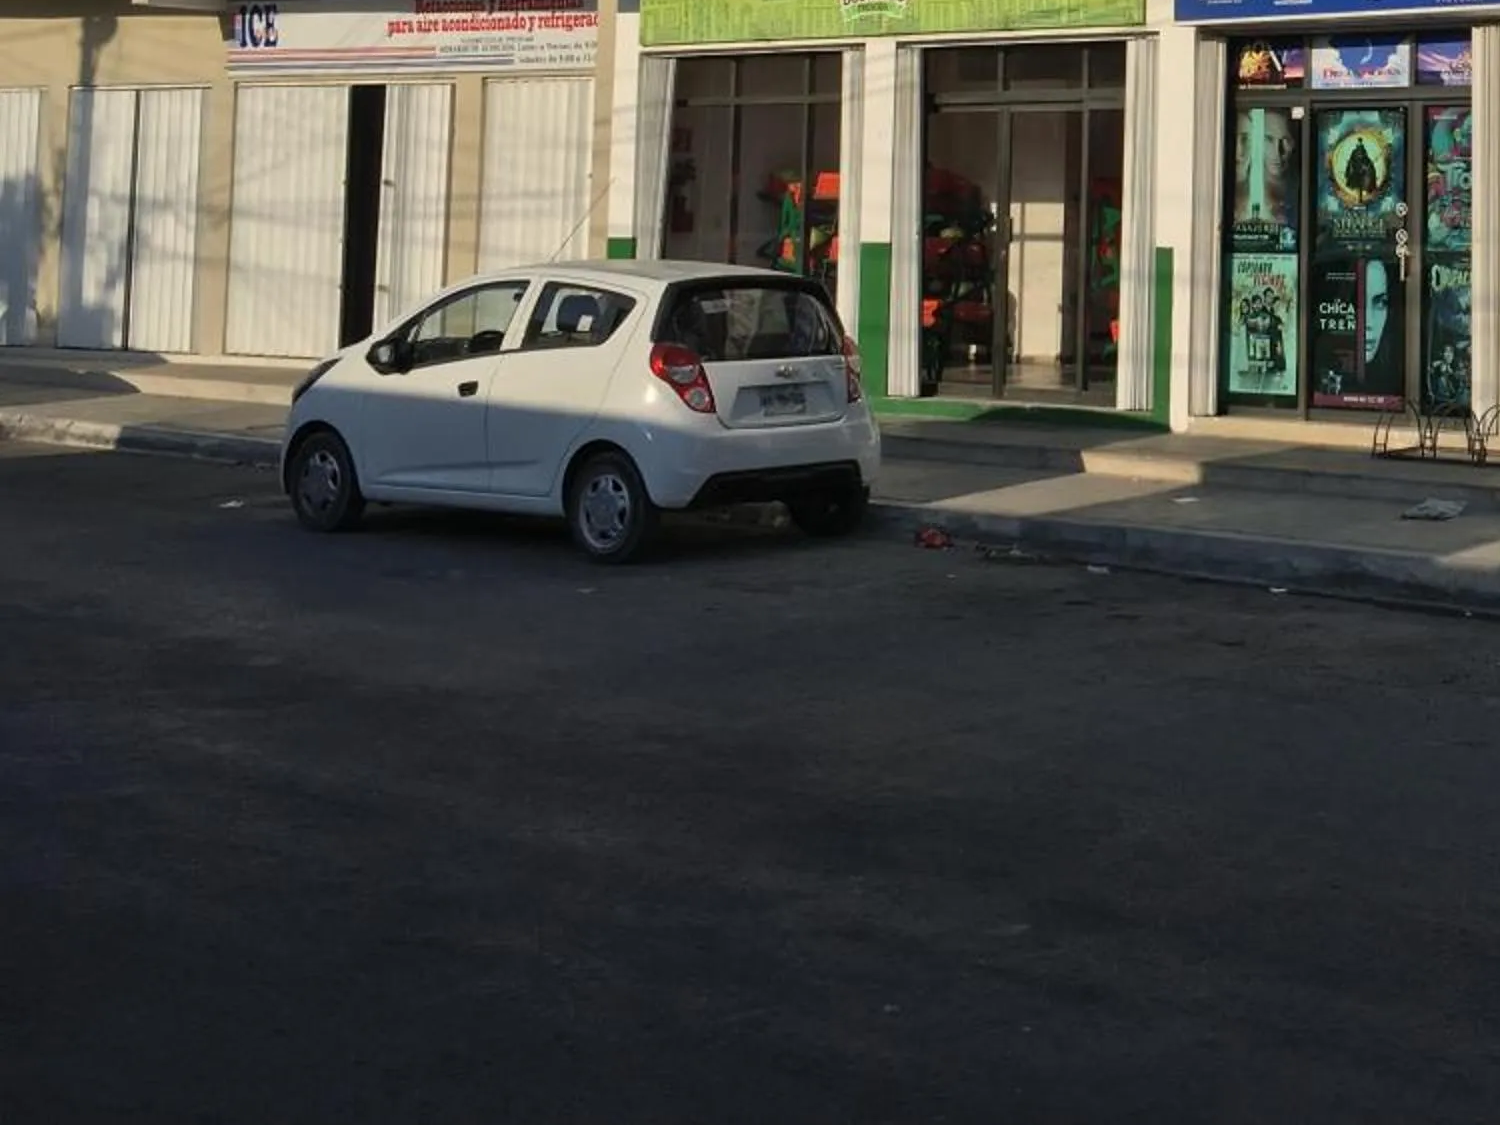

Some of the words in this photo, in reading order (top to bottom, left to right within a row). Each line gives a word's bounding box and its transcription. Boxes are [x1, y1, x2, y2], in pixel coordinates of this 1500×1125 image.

[237, 3, 279, 48] ICE
[387, 19, 415, 37] para
[415, 16, 439, 34] aire
[441, 12, 526, 33] acondicionado
[526, 15, 537, 32] y
[1319, 302, 1356, 315] CHICA
